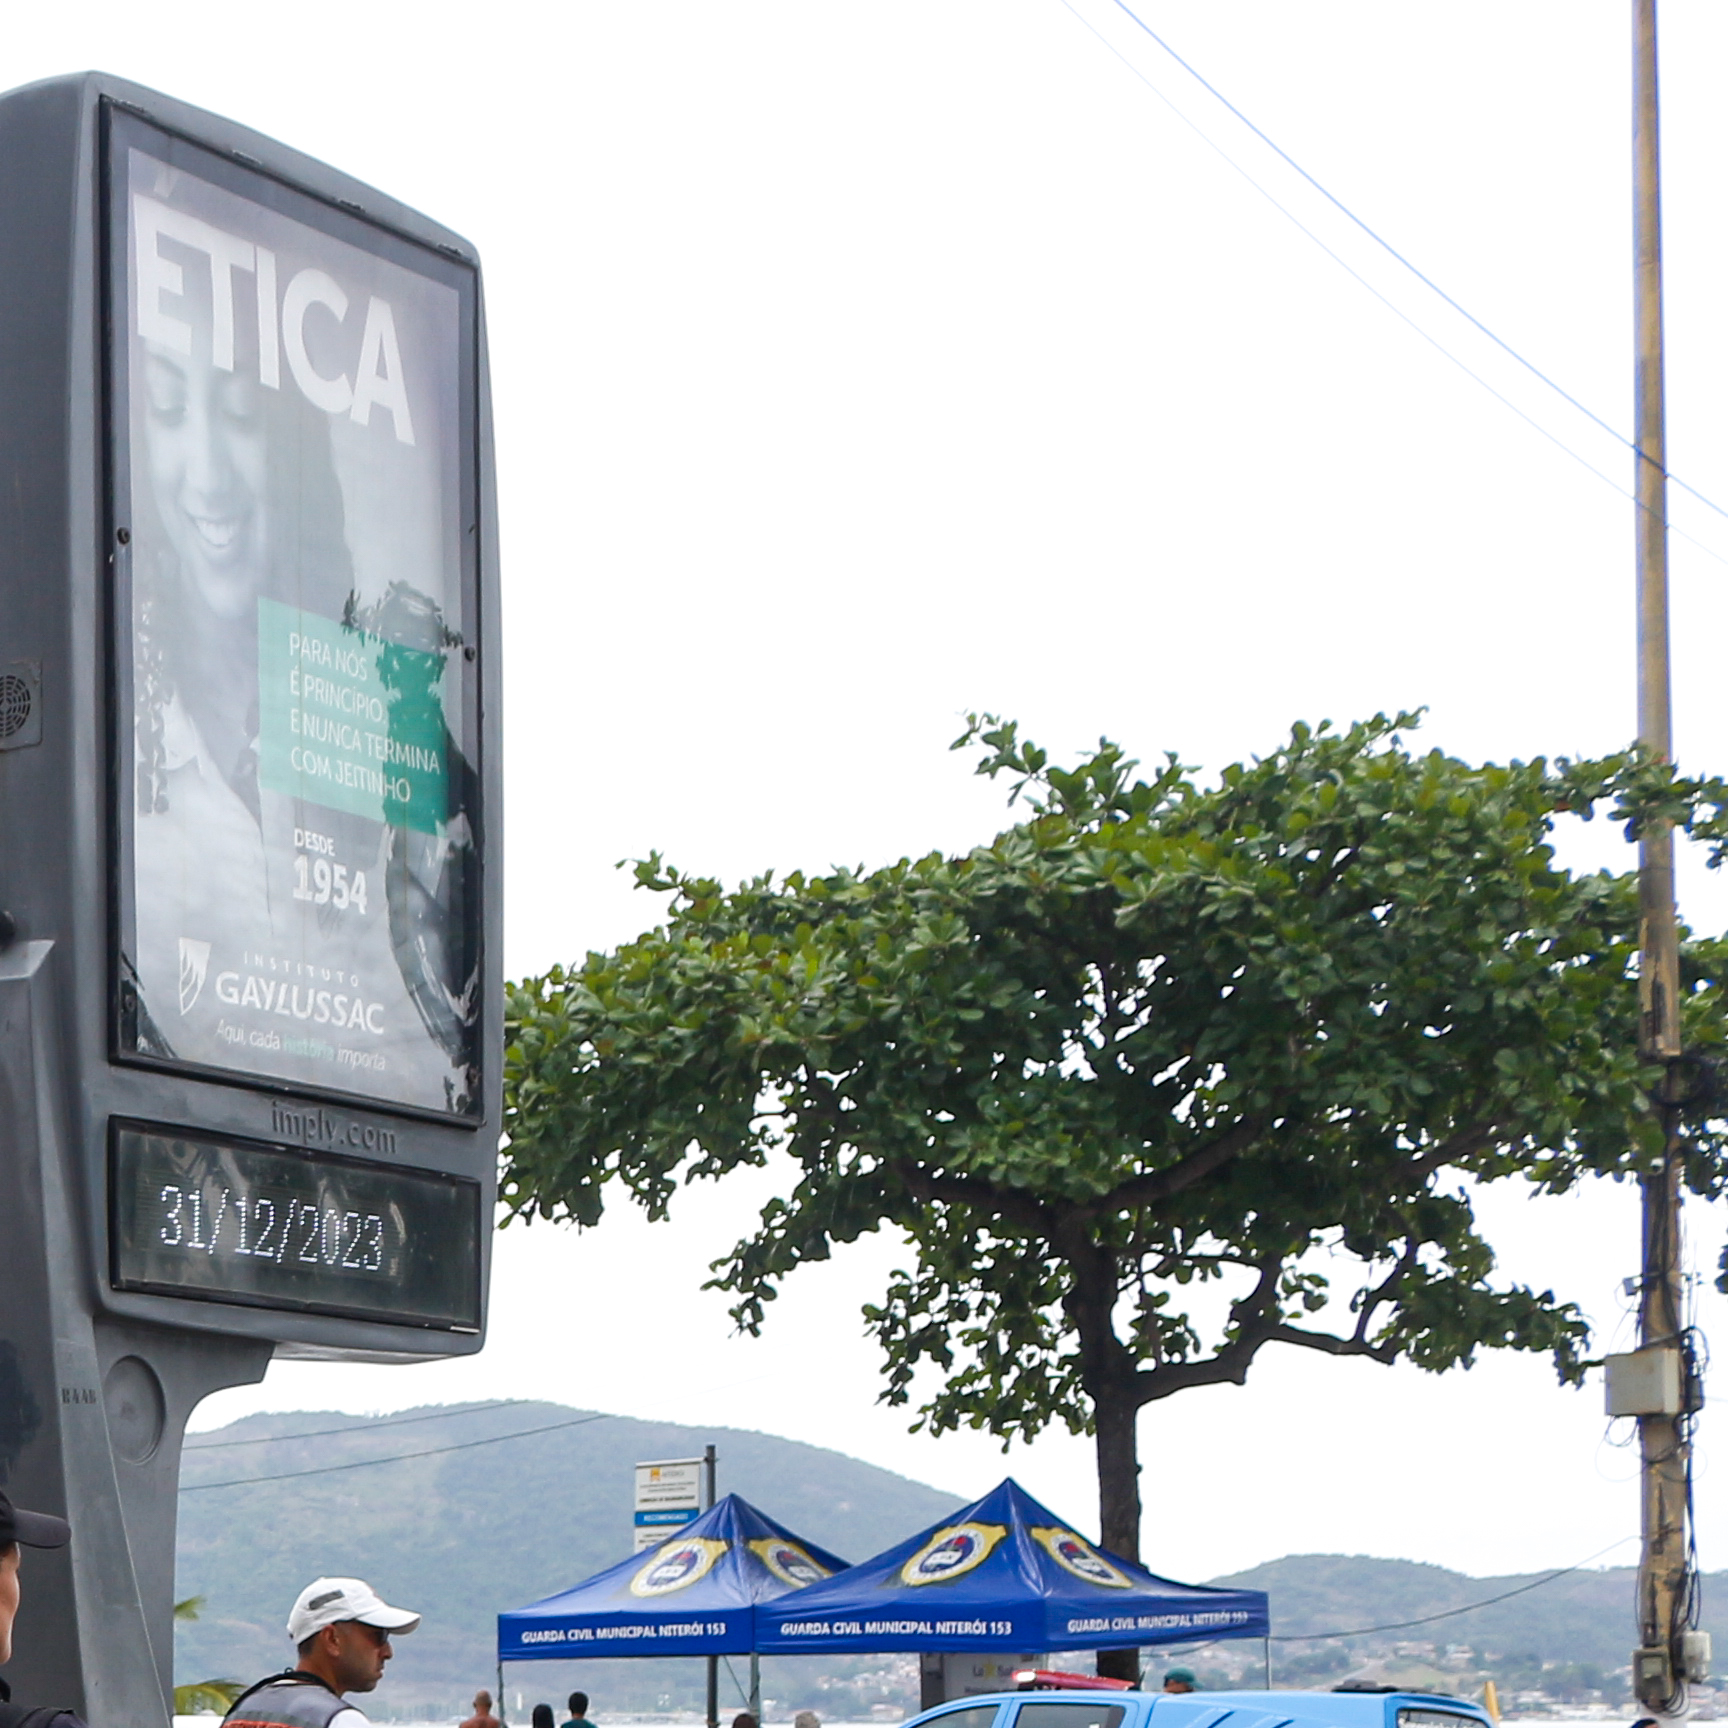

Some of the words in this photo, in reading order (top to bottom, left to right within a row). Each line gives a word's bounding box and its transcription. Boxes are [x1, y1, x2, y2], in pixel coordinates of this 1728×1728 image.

[289, 633, 332, 669] PARA
[335, 646, 367, 681] NÓS
[290, 665, 300, 696] É
[291, 709, 300, 733] E
[303, 713, 362, 753] NUNCA
[364, 732, 440, 775] TERMINA
[291, 747, 332, 781] COM
[335, 760, 411, 803] JEITINHO
[294, 827, 335, 856] DESDE
[292, 854, 367, 915] 1954
[244, 951, 359, 988] INSTITUTO
[216, 1019, 246, 1046] Aqui,
[249, 1030, 280, 1050] cada
[337, 1043, 386, 1071] importa
[270, 1101, 397, 1154] imply.com
[160, 1185, 382, 1271] 31/12/2023
[521, 1629, 566, 1644] GUARDA
[567, 1627, 595, 1641] CIVIL
[596, 1624, 657, 1640] MUNICIPAL
[659, 1620, 704, 1637] NITERÓI
[706, 1622, 726, 1636] 153
[780, 1622, 830, 1635] GUARDA
[832, 1621, 862, 1635] CIVIL
[865, 1620, 933, 1635] MUNICIPAL
[936, 1618, 987, 1635] NITERÓI
[990, 1620, 1012, 1635] 153
[1067, 1618, 1110, 1634] GUARDA
[1112, 1616, 1137, 1631] CIVIL
[1138, 1613, 1192, 1629] MUNICIPAL
[1193, 1609, 1231, 1626] NITERÓI
